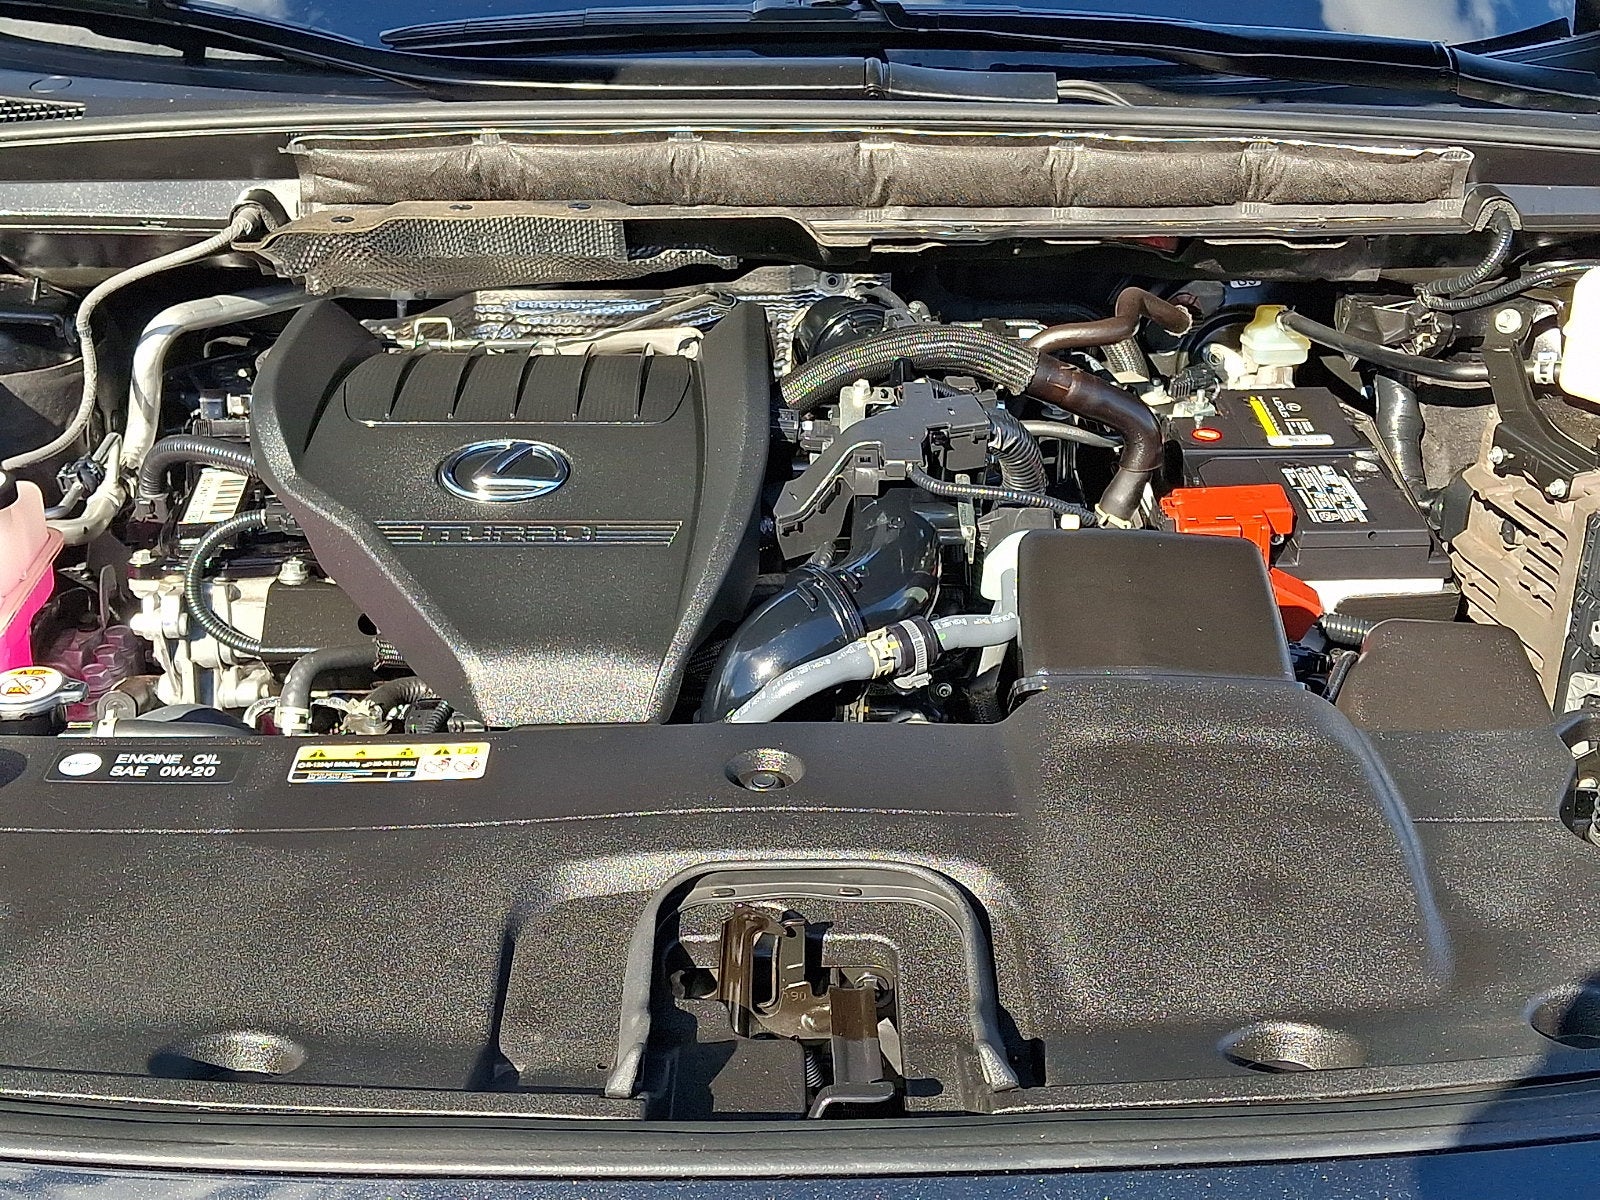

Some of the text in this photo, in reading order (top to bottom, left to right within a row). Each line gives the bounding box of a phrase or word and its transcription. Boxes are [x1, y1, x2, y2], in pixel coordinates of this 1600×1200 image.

[428, 525, 591, 541] TURBO
[114, 753, 221, 765] ENGINE OIL
[109, 765, 216, 777] SAE 0W-20
